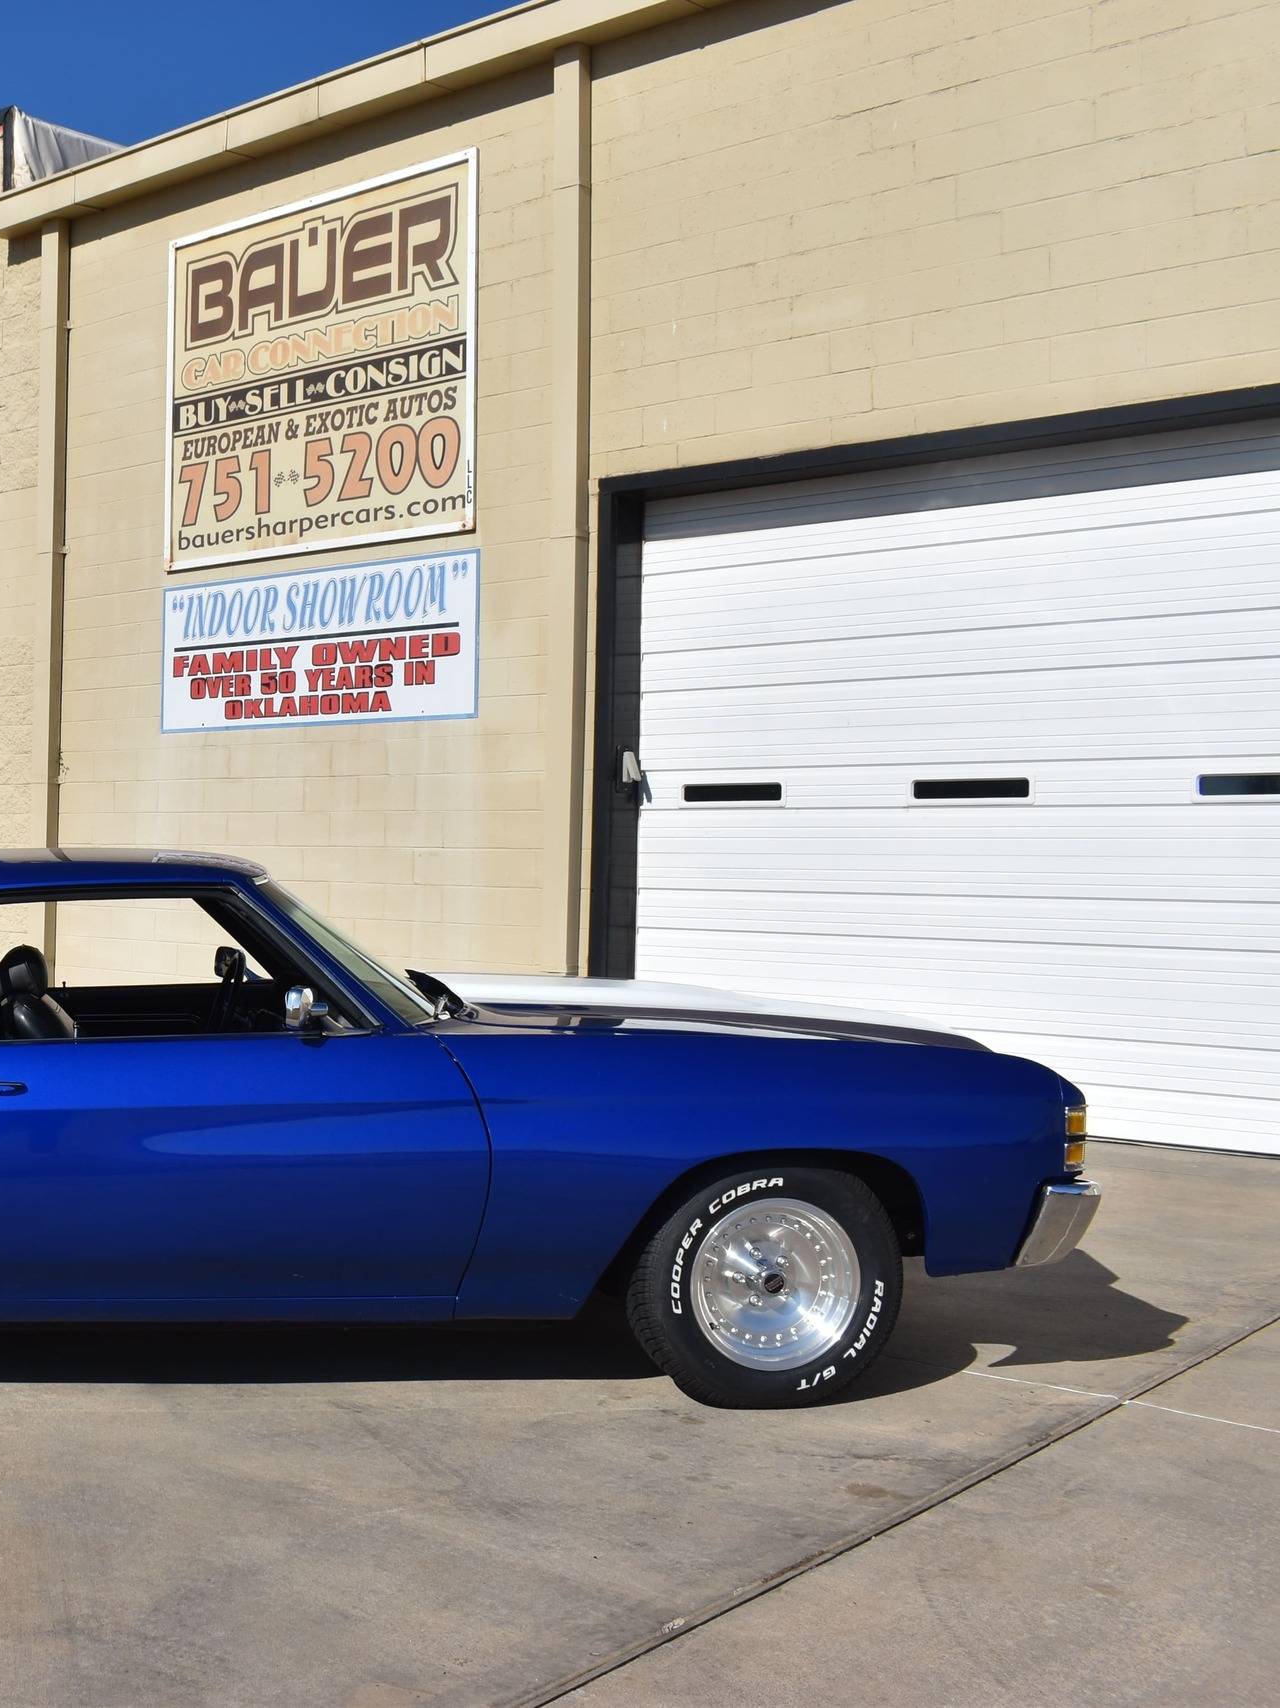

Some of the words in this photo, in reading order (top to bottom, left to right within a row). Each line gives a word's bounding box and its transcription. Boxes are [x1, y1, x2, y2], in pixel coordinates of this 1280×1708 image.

[182, 349, 246, 391] CAR
[247, 294, 459, 375] CONNECTION
[179, 395, 231, 430] BUY
[244, 378, 312, 415] SELL
[325, 344, 463, 398] CONSIGN
[181, 420, 281, 461] EUROPEAN
[285, 418, 299, 440] &
[303, 401, 379, 437] EXOTIC
[382, 385, 458, 417] AUTOS
[178, 448, 271, 528] 751
[303, 415, 461, 508] 5200
[178, 493, 466, 551] bauersharpercars.com
[172, 645, 299, 678] FAMILY
[311, 631, 461, 667] OWNED
[190, 674, 252, 700] OVER
[260, 670, 297, 695] 50
[304, 663, 393, 693] YEARS
[403, 659, 436, 686] IN
[224, 690, 392, 721] OKLAHOMA
[671, 1218, 703, 1315] COOPER
[708, 1177, 784, 1215] COBRA
[843, 1279, 885, 1359] RADIAL
[796, 1364, 837, 1391] G/T
